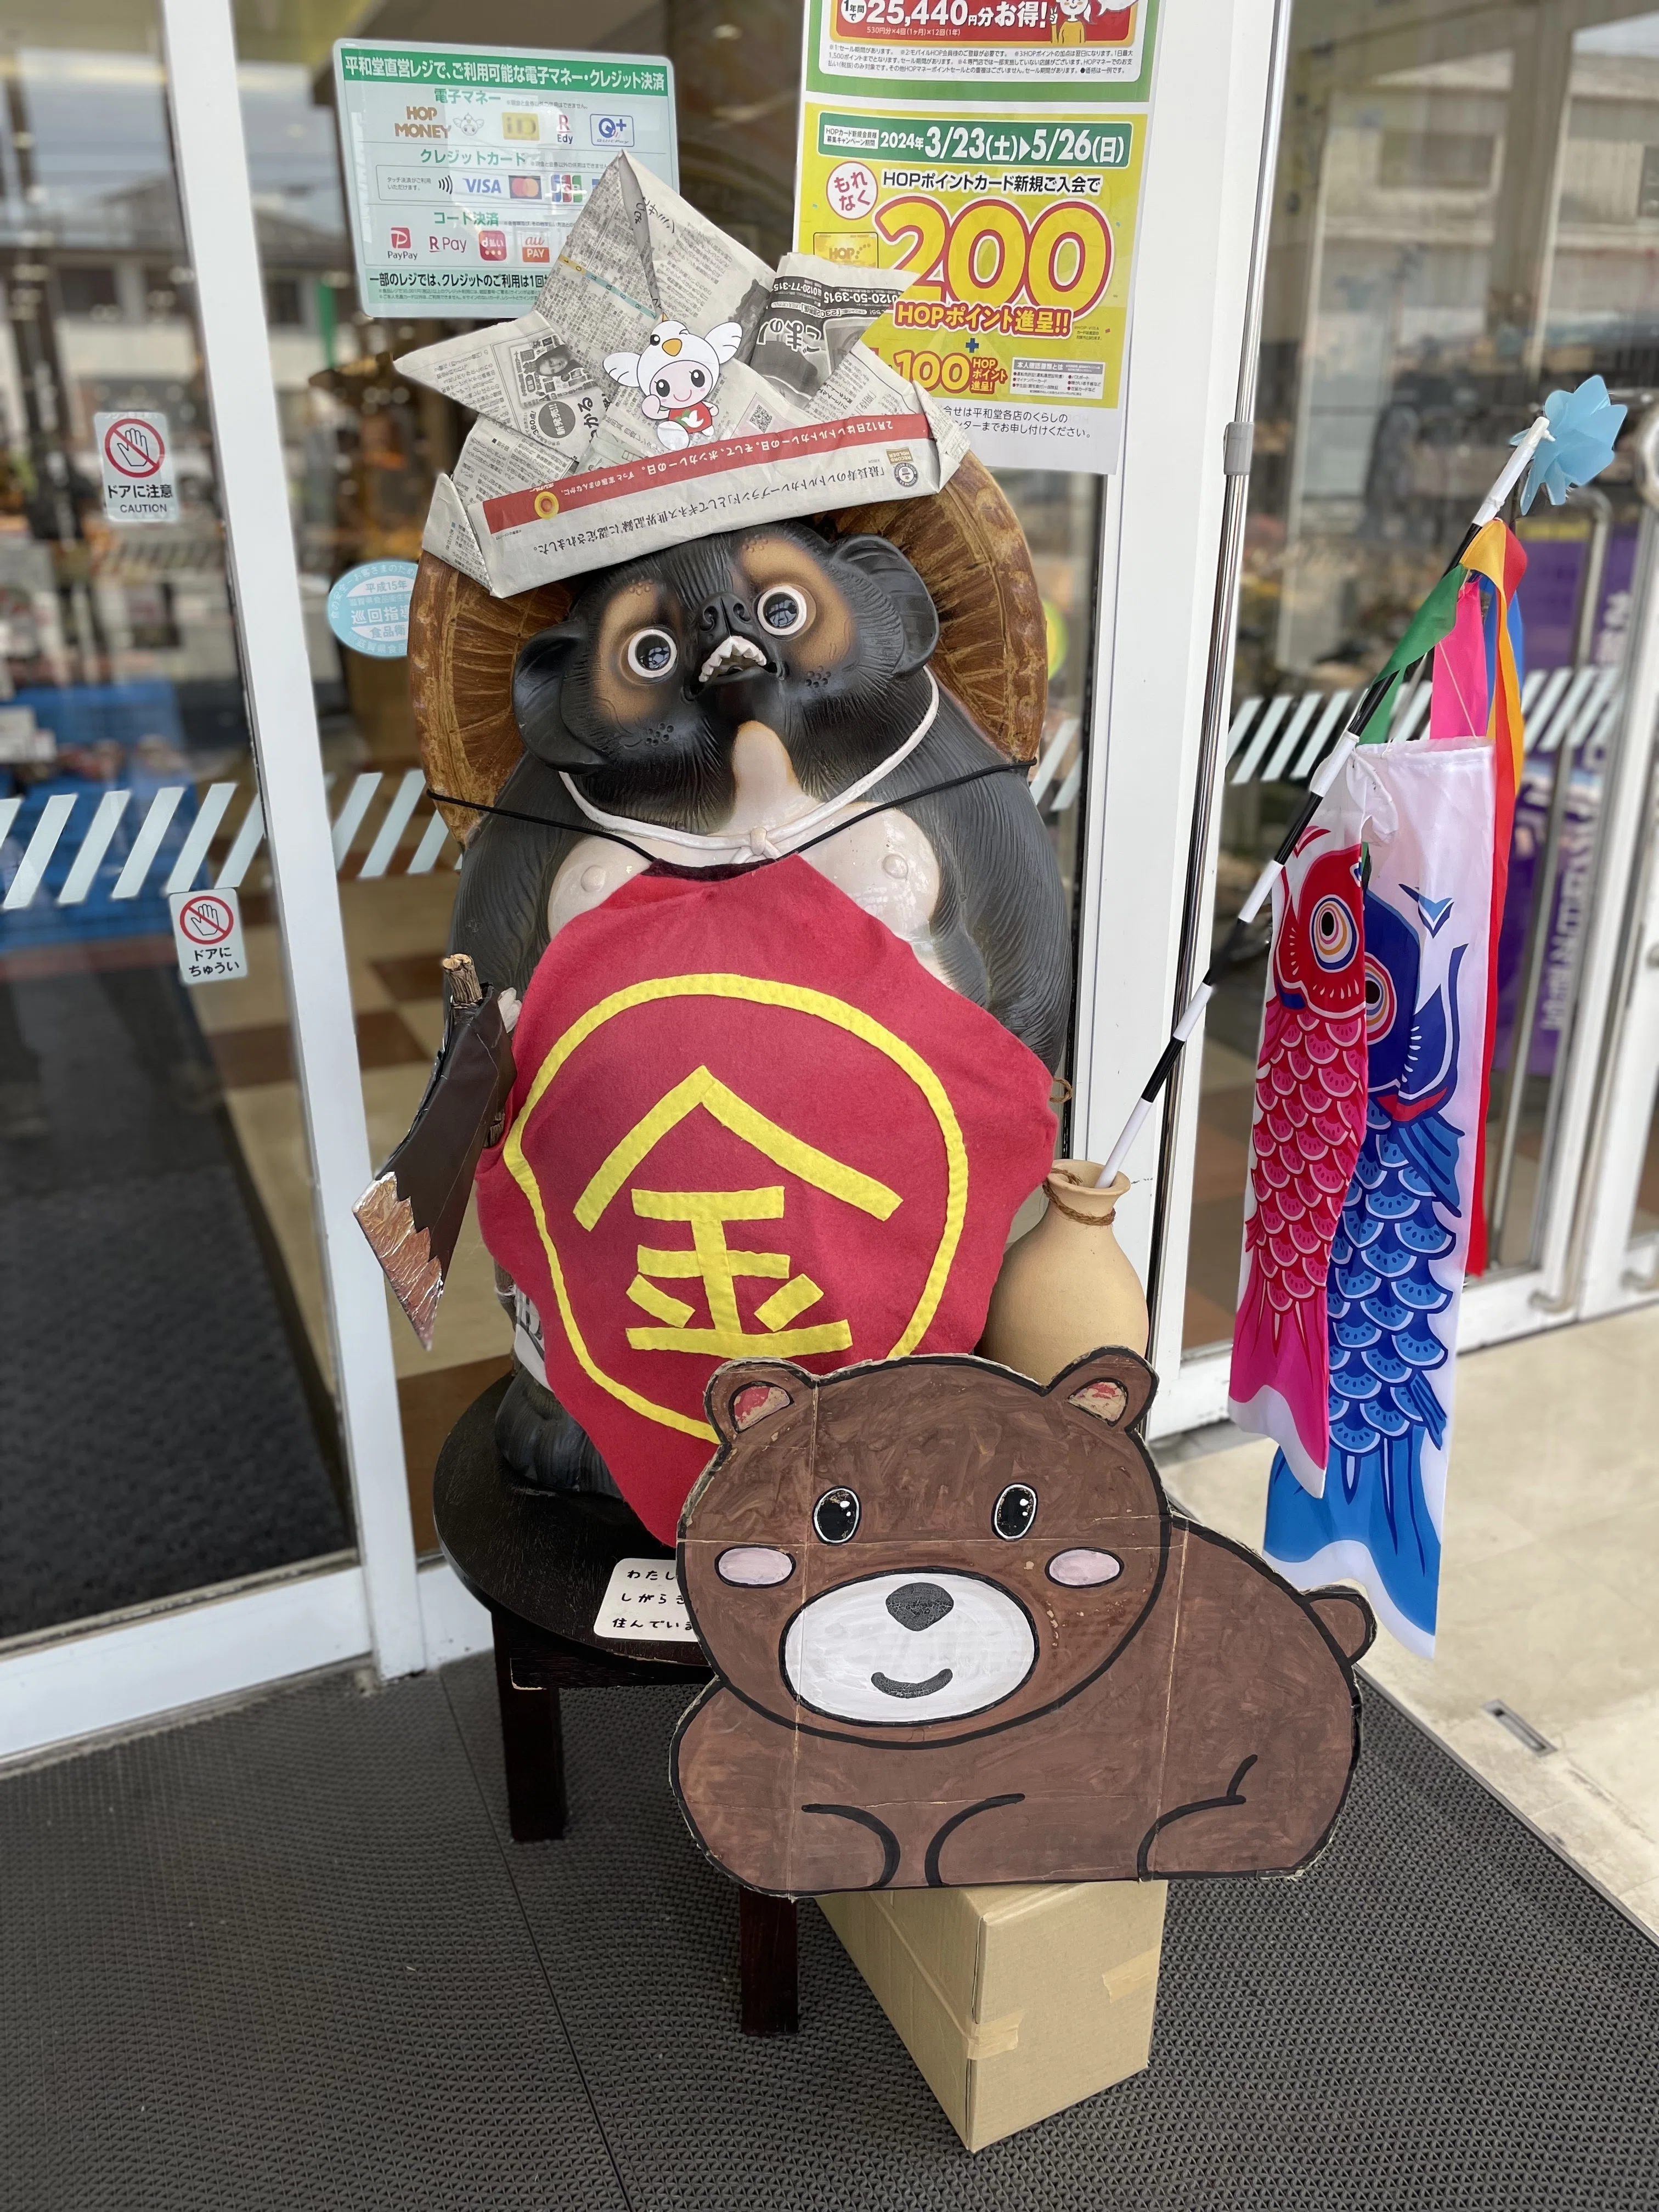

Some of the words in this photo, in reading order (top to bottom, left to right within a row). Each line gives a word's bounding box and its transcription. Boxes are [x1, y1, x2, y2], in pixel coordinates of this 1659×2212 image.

[345, 56, 665, 92] 平和堂直営レジで、ご利用可能な電子マネー・クレジット決済
[434, 88, 501, 104] 電子マネー
[407, 106, 437, 121] HOP
[394, 122, 452, 139] MONEY
[557, 134, 573, 144] Edy
[880, 131, 924, 150] 2024年
[420, 149, 526, 166] クレジットカード
[462, 178, 501, 194] VISA
[834, 171, 868, 193] もれ
[883, 171, 1101, 194] HOPポイントカード新規ご入会で
[838, 192, 871, 211] なく
[434, 211, 499, 227] コード決済
[443, 236, 467, 253] Pay
[525, 236, 545, 246] au
[387, 251, 418, 261] PayPay
[526, 248, 545, 258] PAY
[829, 247, 855, 259] HOP
[875, 195, 1113, 319] 200
[896, 303, 1068, 334] HOPポイント進呈!!
[973, 358, 996, 369] HOP
[894, 350, 971, 394] 100
[972, 368, 1006, 381] ポイント
[970, 380, 992, 392] 進呈!
[107, 484, 173, 499] ドアに注意
[120, 504, 167, 513] CAUTION
[365, 579, 408, 593] 平成15年
[194, 947, 232, 962] ドアに
[188, 961, 240, 977] ちゅうい
[573, 1065, 904, 1359] 金
[627, 1570, 675, 1581] わたし
